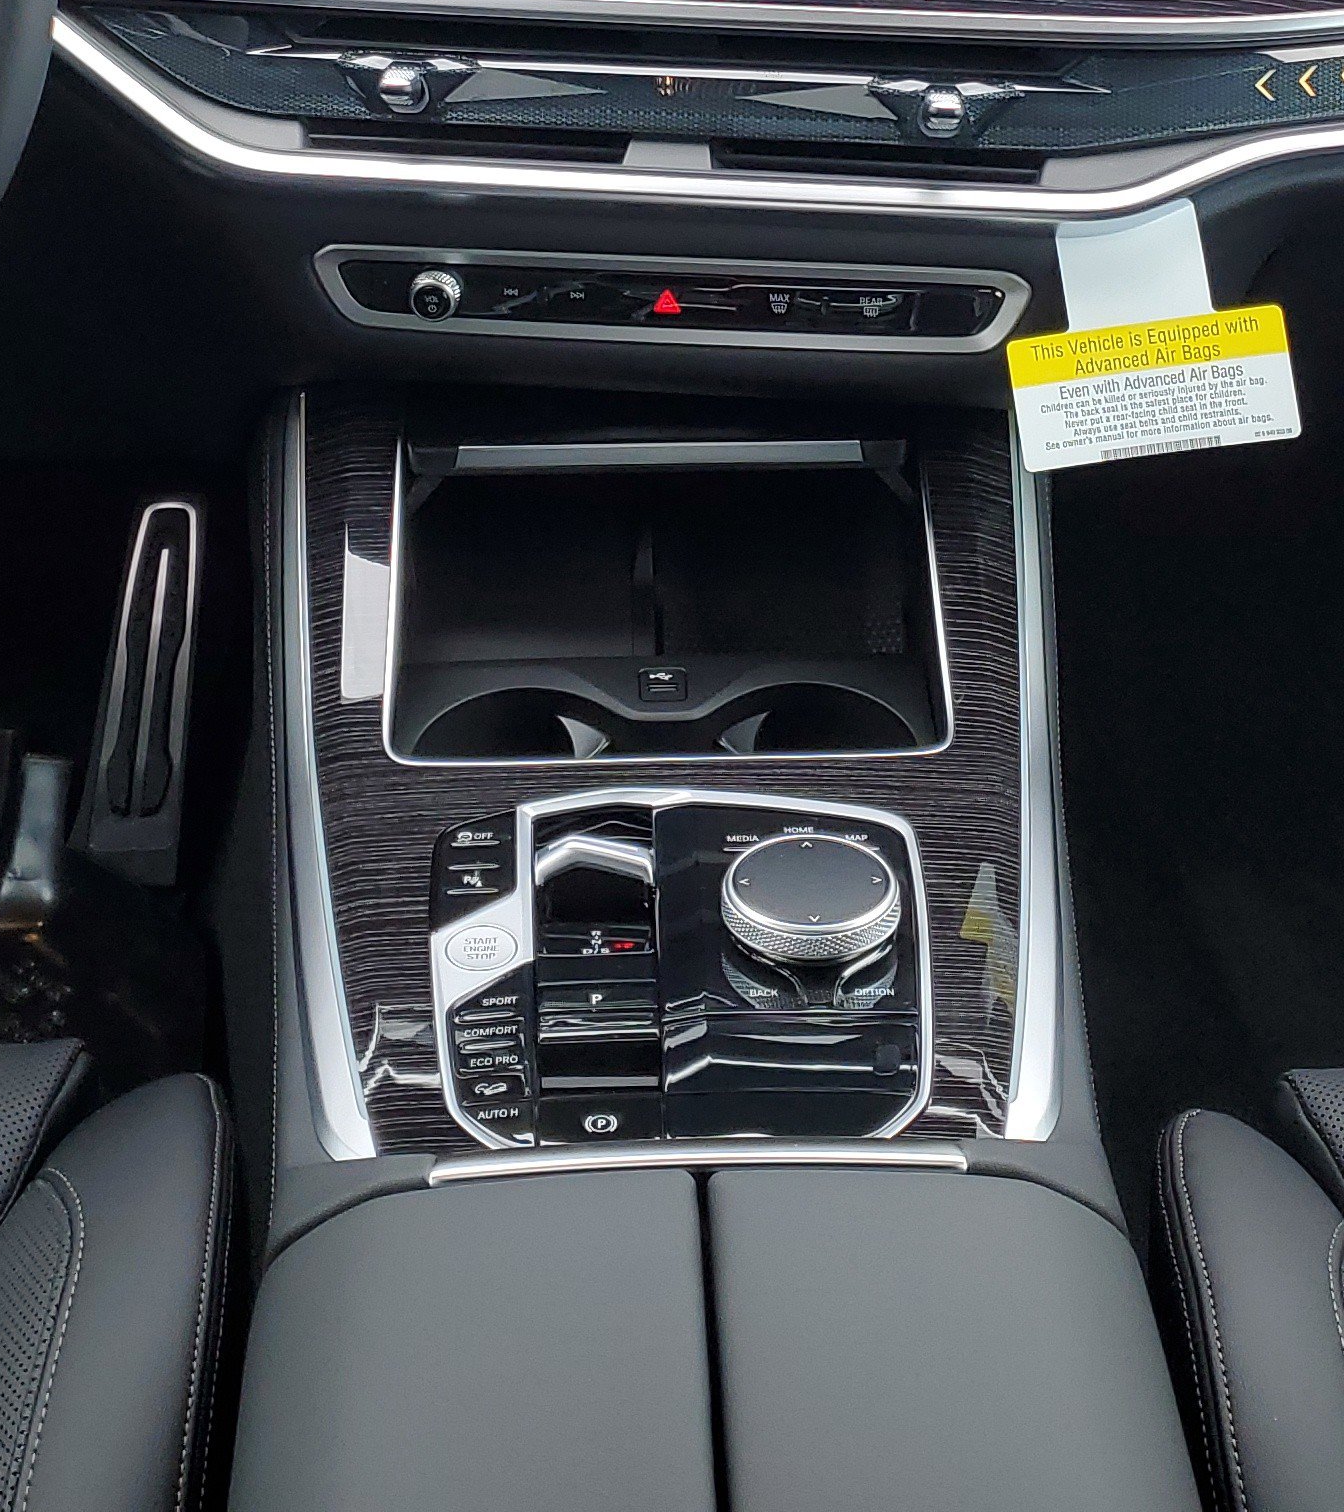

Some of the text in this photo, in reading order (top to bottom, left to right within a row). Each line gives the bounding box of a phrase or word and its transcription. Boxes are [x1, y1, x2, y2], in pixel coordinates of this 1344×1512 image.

[769, 293, 790, 303] MAX
[1030, 316, 1259, 361] This Vehicle is Equipped with
[1075, 344, 1221, 375] Advanced Air Bags
[1059, 364, 1244, 400] Even with Advanced Air Bags
[1040, 402, 1073, 414] Children
[1075, 399, 1090, 408] can
[1138, 386, 1175, 399] seriously
[1081, 407, 1100, 417] back
[1172, 393, 1193, 404] place
[1158, 404, 1177, 416] child
[1161, 414, 1176, 424] and
[1095, 431, 1124, 443] manual
[1141, 427, 1162, 437] more
[1163, 419, 1211, 434] information
[1213, 417, 1236, 428] about
[473, 832, 494, 840] OFF
[783, 826, 814, 834] HOME
[845, 833, 868, 842] MAP
[464, 937, 498, 945] START
[463, 945, 500, 953] ENGINE
[482, 995, 518, 1007] SPORT
[591, 993, 603, 1005] P
[464, 1025, 518, 1037] COMFORT
[470, 1055, 518, 1067] ECO PRO
[477, 1107, 519, 1120] AUTO H
